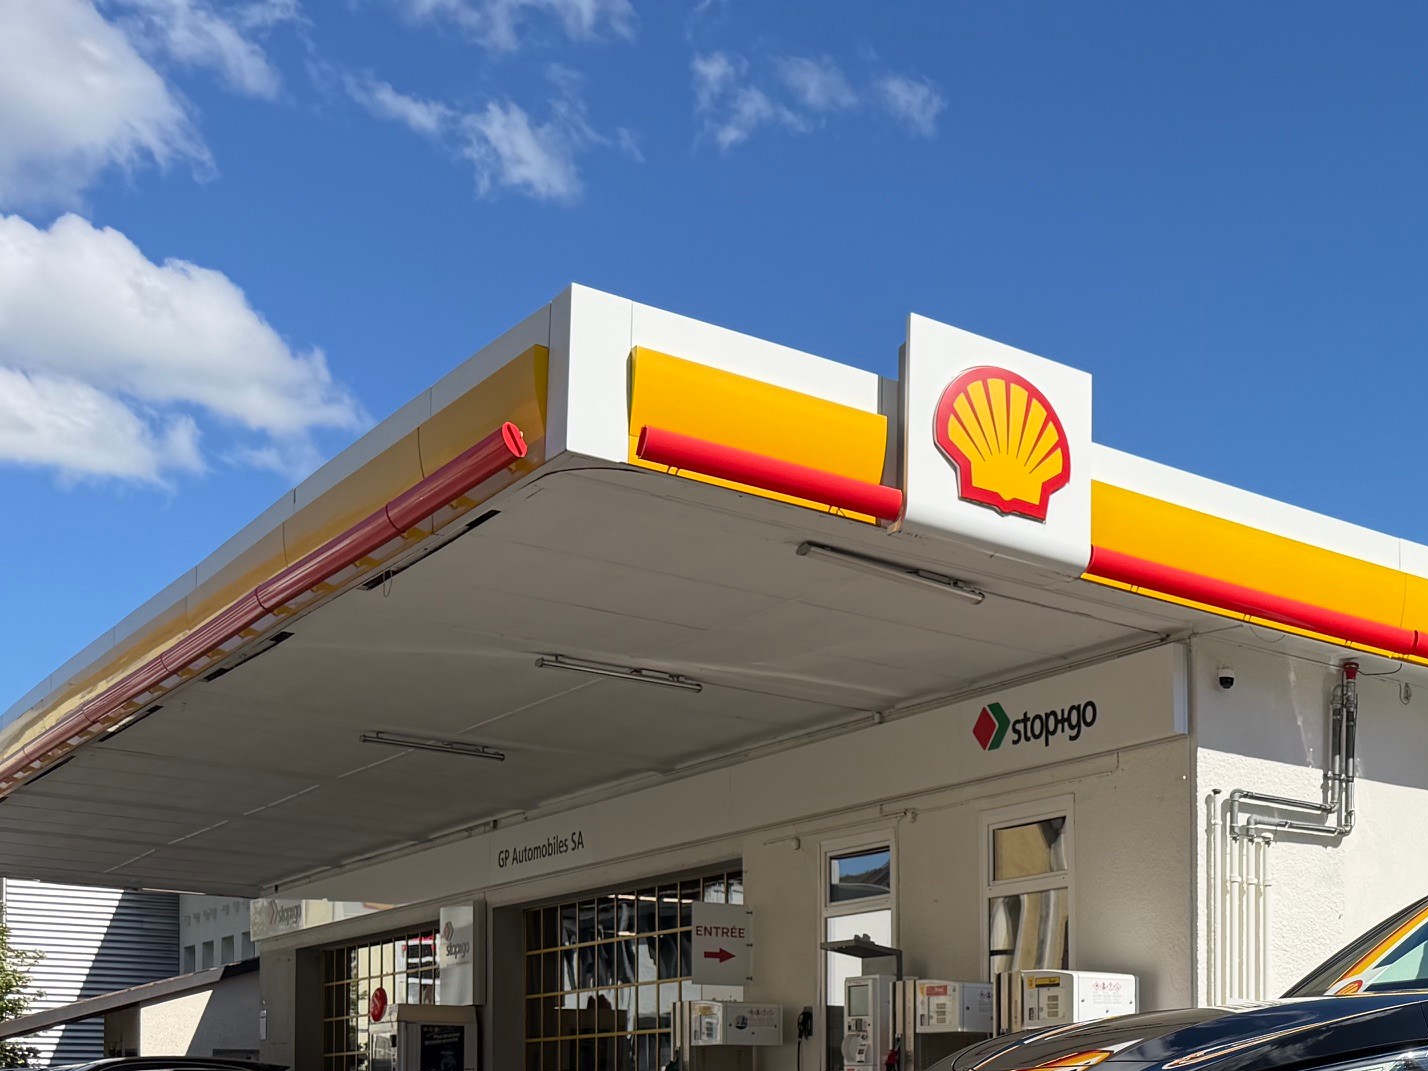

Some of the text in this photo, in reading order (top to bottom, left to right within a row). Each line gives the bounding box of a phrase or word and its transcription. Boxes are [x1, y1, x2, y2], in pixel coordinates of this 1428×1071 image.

[1012, 700, 1097, 747] stop+go
[498, 830, 585, 868] GP Automobiles SA
[695, 925, 746, 939] ENTRÉE
